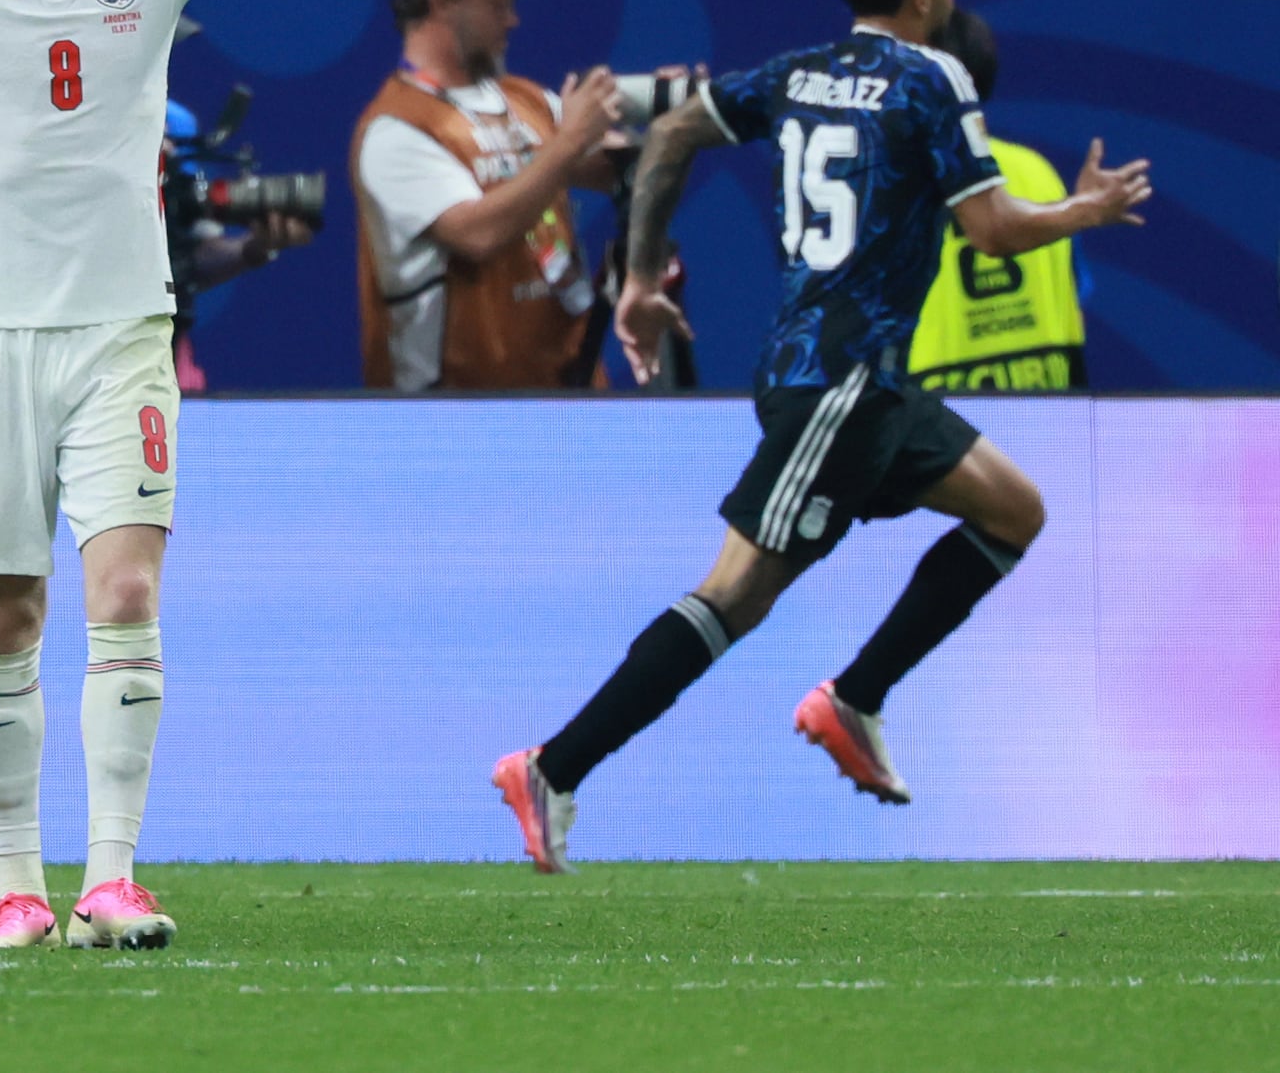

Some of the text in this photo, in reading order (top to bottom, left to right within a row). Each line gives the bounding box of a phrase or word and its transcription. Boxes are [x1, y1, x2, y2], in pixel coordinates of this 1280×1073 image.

[48, 39, 83, 111] 8
[778, 118, 859, 271] 15
[138, 405, 168, 474] 8
